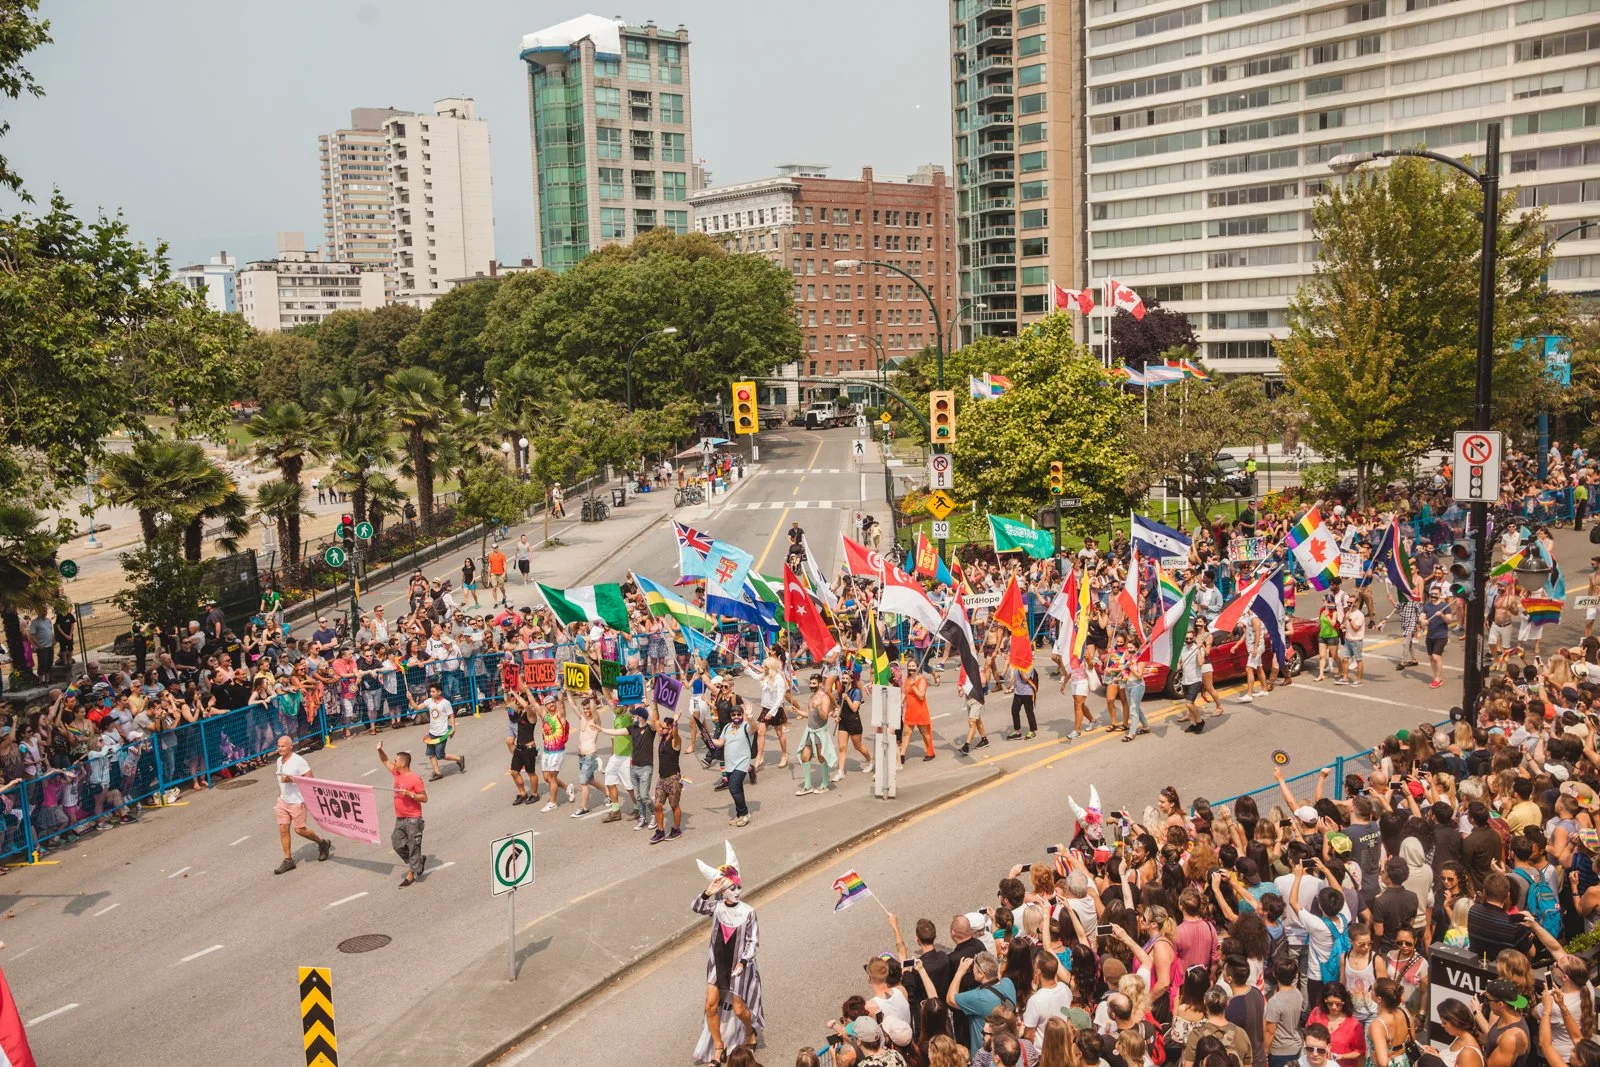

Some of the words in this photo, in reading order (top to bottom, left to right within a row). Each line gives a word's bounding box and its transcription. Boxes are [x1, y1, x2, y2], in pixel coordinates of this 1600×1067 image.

[934, 522, 947, 532] 30
[524, 663, 555, 683] REFUGEES
[567, 667, 584, 688] We
[658, 677, 677, 705] You
[312, 786, 361, 801] FOUNDATION
[316, 796, 364, 823] HOPE
